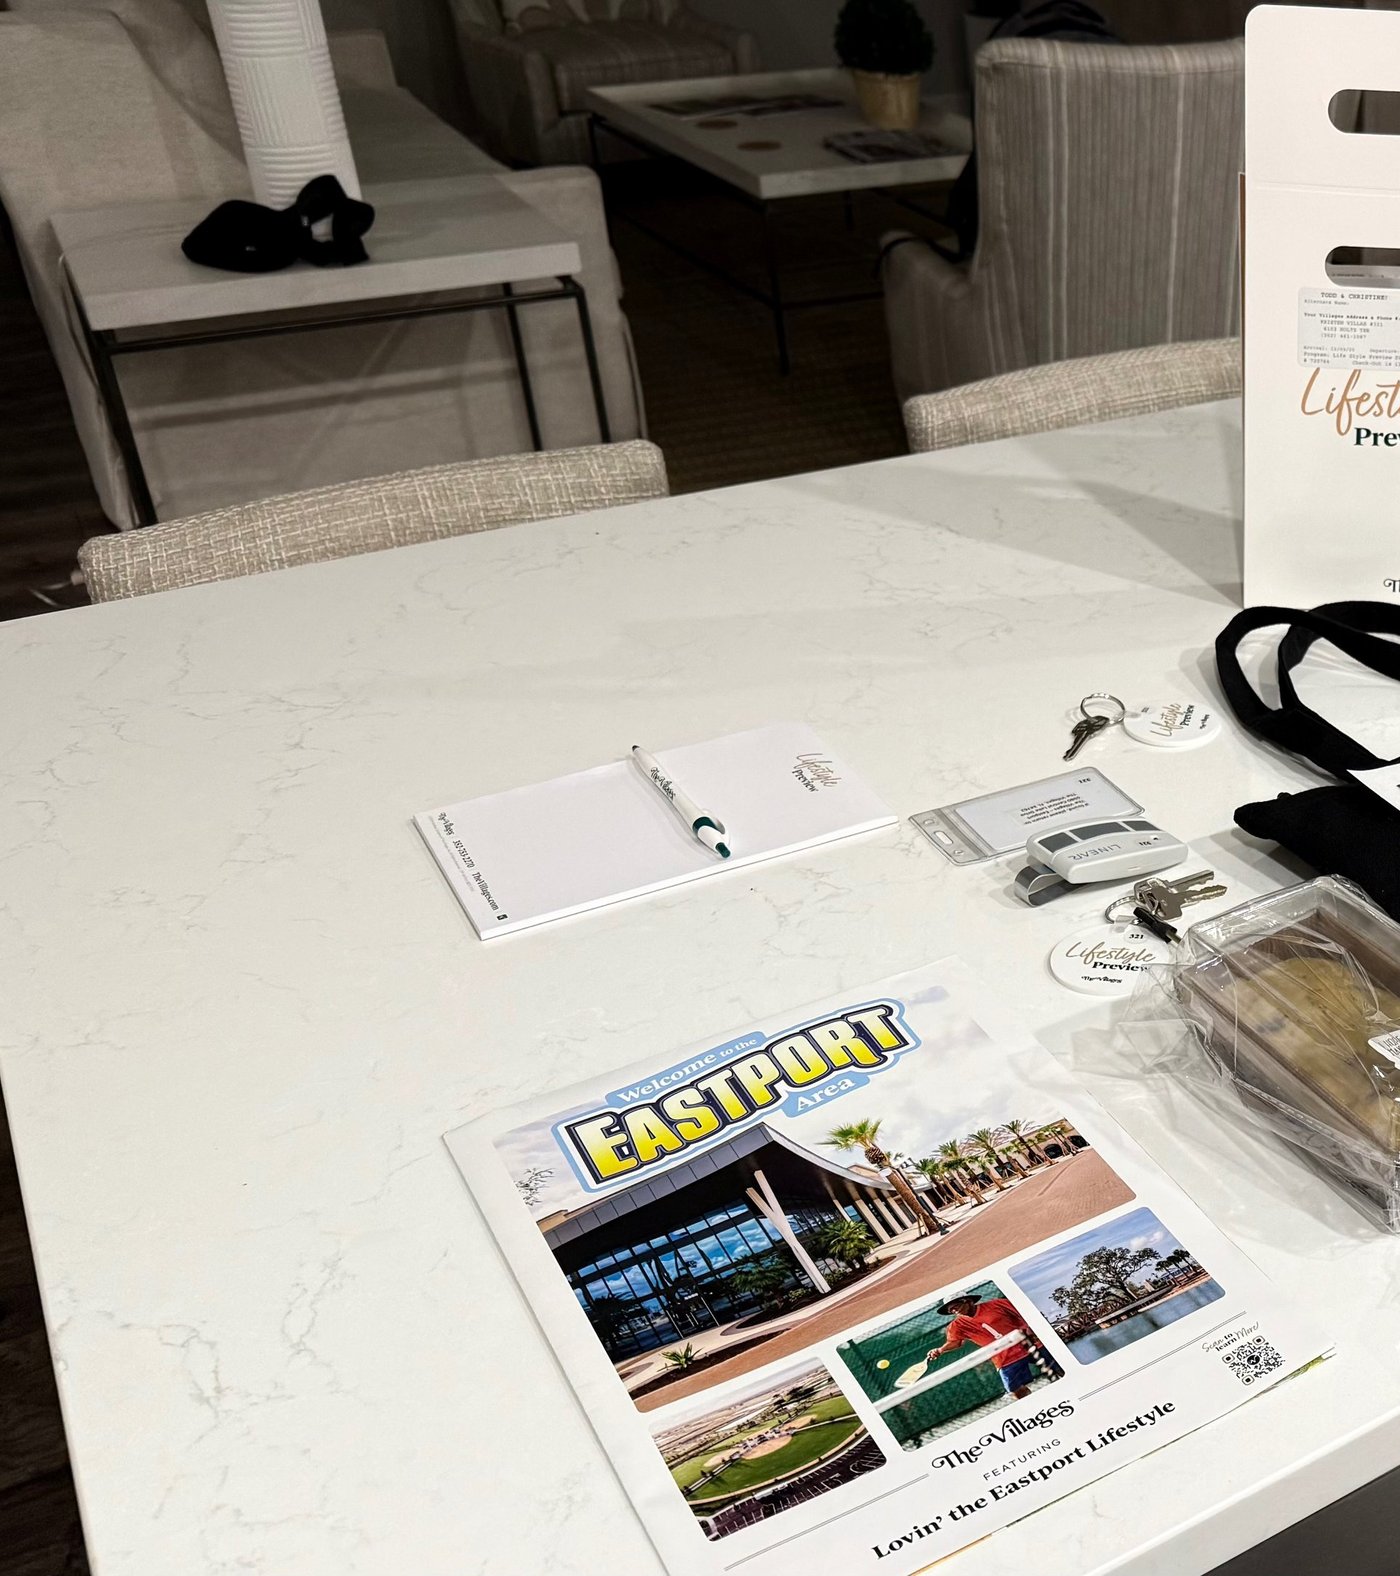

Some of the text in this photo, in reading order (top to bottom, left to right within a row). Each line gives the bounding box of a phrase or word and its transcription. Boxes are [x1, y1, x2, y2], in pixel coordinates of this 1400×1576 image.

[1179, 705, 1195, 726] Preview
[792, 769, 819, 792] Preview
[794, 753, 842, 787] Lifestyle
[1068, 844, 1121, 860] LINEAR
[1066, 941, 1156, 965] Lifestyle
[1092, 961, 1149, 972] Preview
[616, 1036, 757, 1105] Welcome to the
[568, 1004, 907, 1181] EASTPORT
[795, 1077, 855, 1111] Area
[1202, 1339, 1224, 1352] Scan
[1215, 1337, 1237, 1351] learn
[931, 1399, 1077, 1472] The Villages
[983, 1438, 1063, 1481] FEATURING
[870, 1399, 1177, 1560] Lovin’ the Eastport Lifestyle
